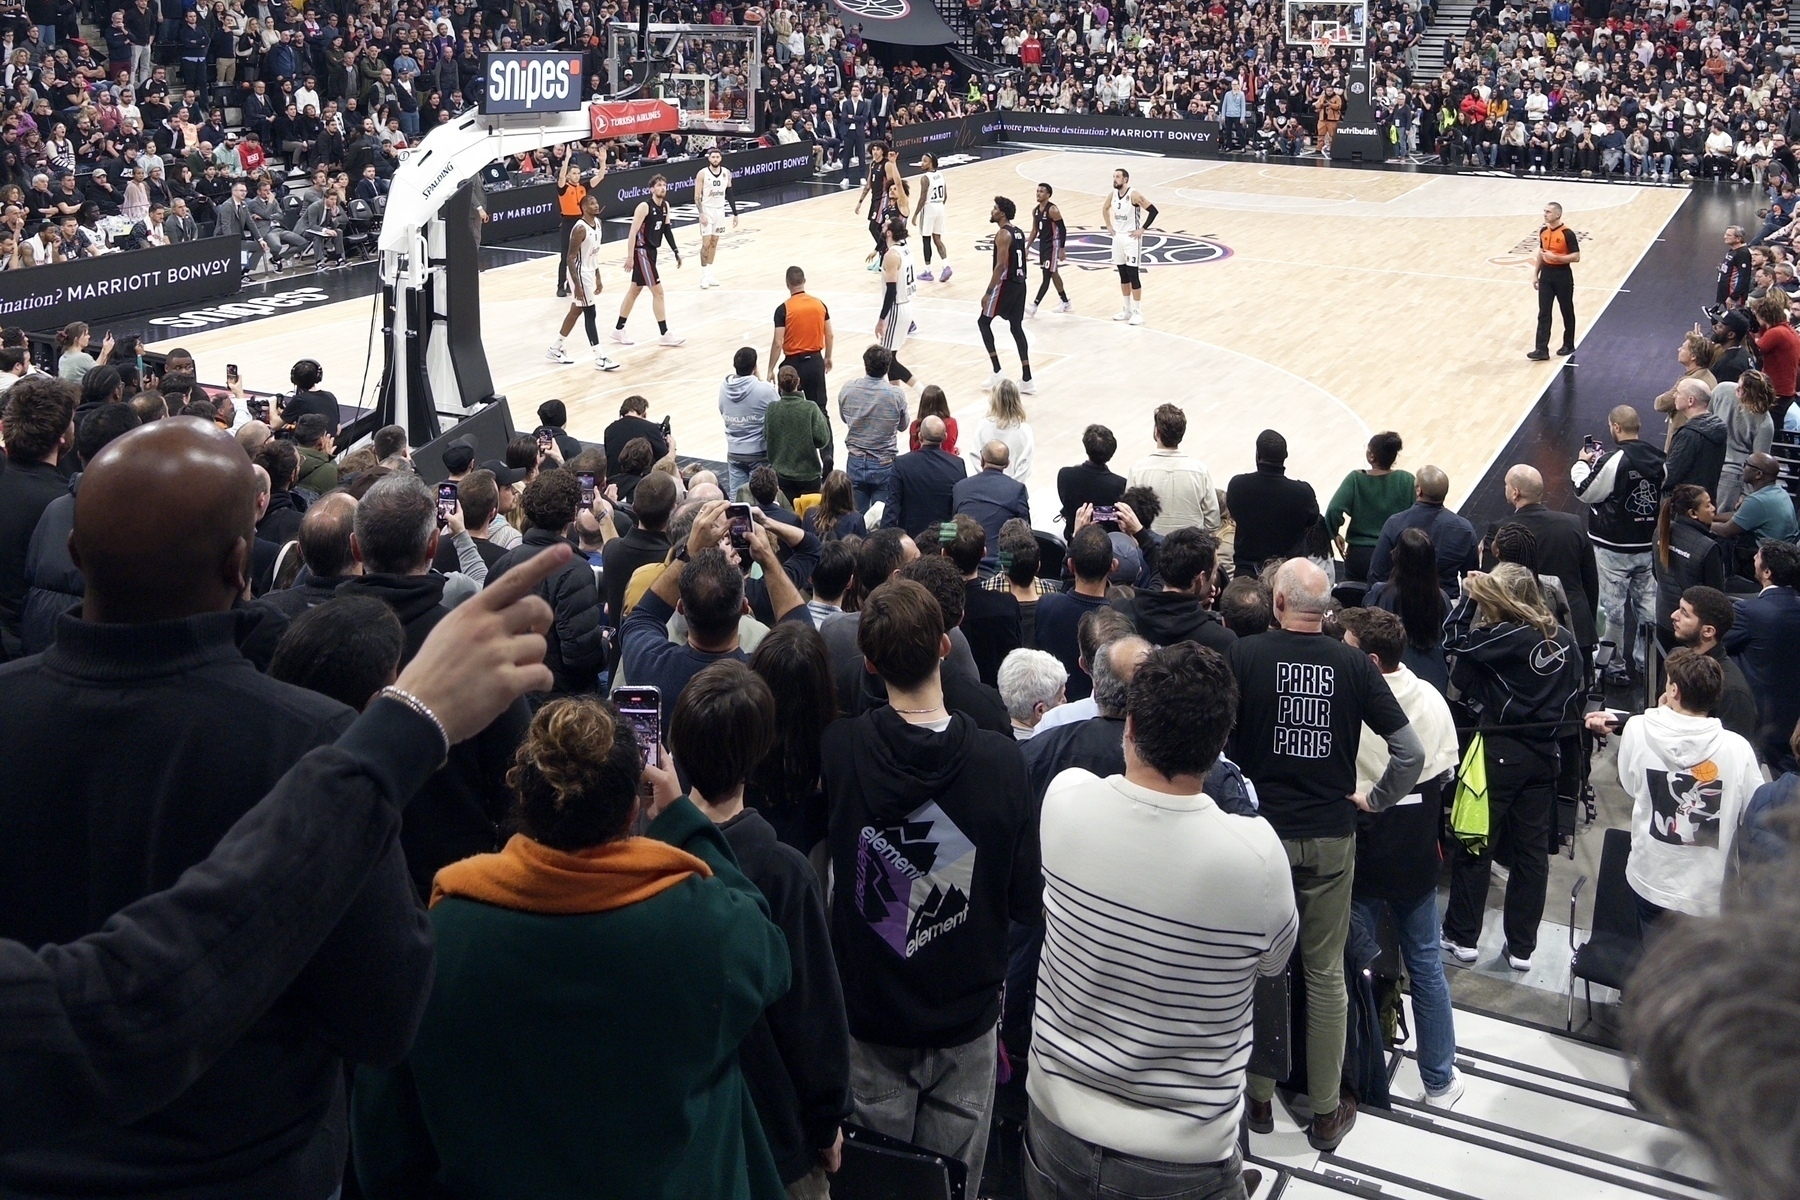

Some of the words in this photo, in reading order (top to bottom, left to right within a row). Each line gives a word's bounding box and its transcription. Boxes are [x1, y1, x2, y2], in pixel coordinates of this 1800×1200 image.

[490, 60, 571, 109] snipes
[610, 117, 636, 127] TURKISH
[636, 110, 662, 123] AIRLINES
[1003, 123, 1022, 132] votre
[1023, 123, 1061, 135] prochaine
[1062, 125, 1109, 137] destination?
[1110, 128, 1165, 140] MARRIOTT
[895, 137, 922, 148] COURTYARD
[929, 132, 951, 142] MARRIOTT
[422, 161, 454, 200] SPALDING
[617, 186, 640, 202] Quelle
[744, 160, 781, 176] MARRIOTT
[492, 211, 504, 222] BY
[507, 202, 553, 220] MARRIOTT
[67, 270, 162, 302] MARRIOTT
[149, 287, 329, 328] snipes
[1276, 662, 1334, 697] PARIS
[1277, 695, 1331, 728] POUR
[1273, 726, 1333, 758] PARIS
[860, 825, 926, 881] element
[905, 902, 970, 958] element
